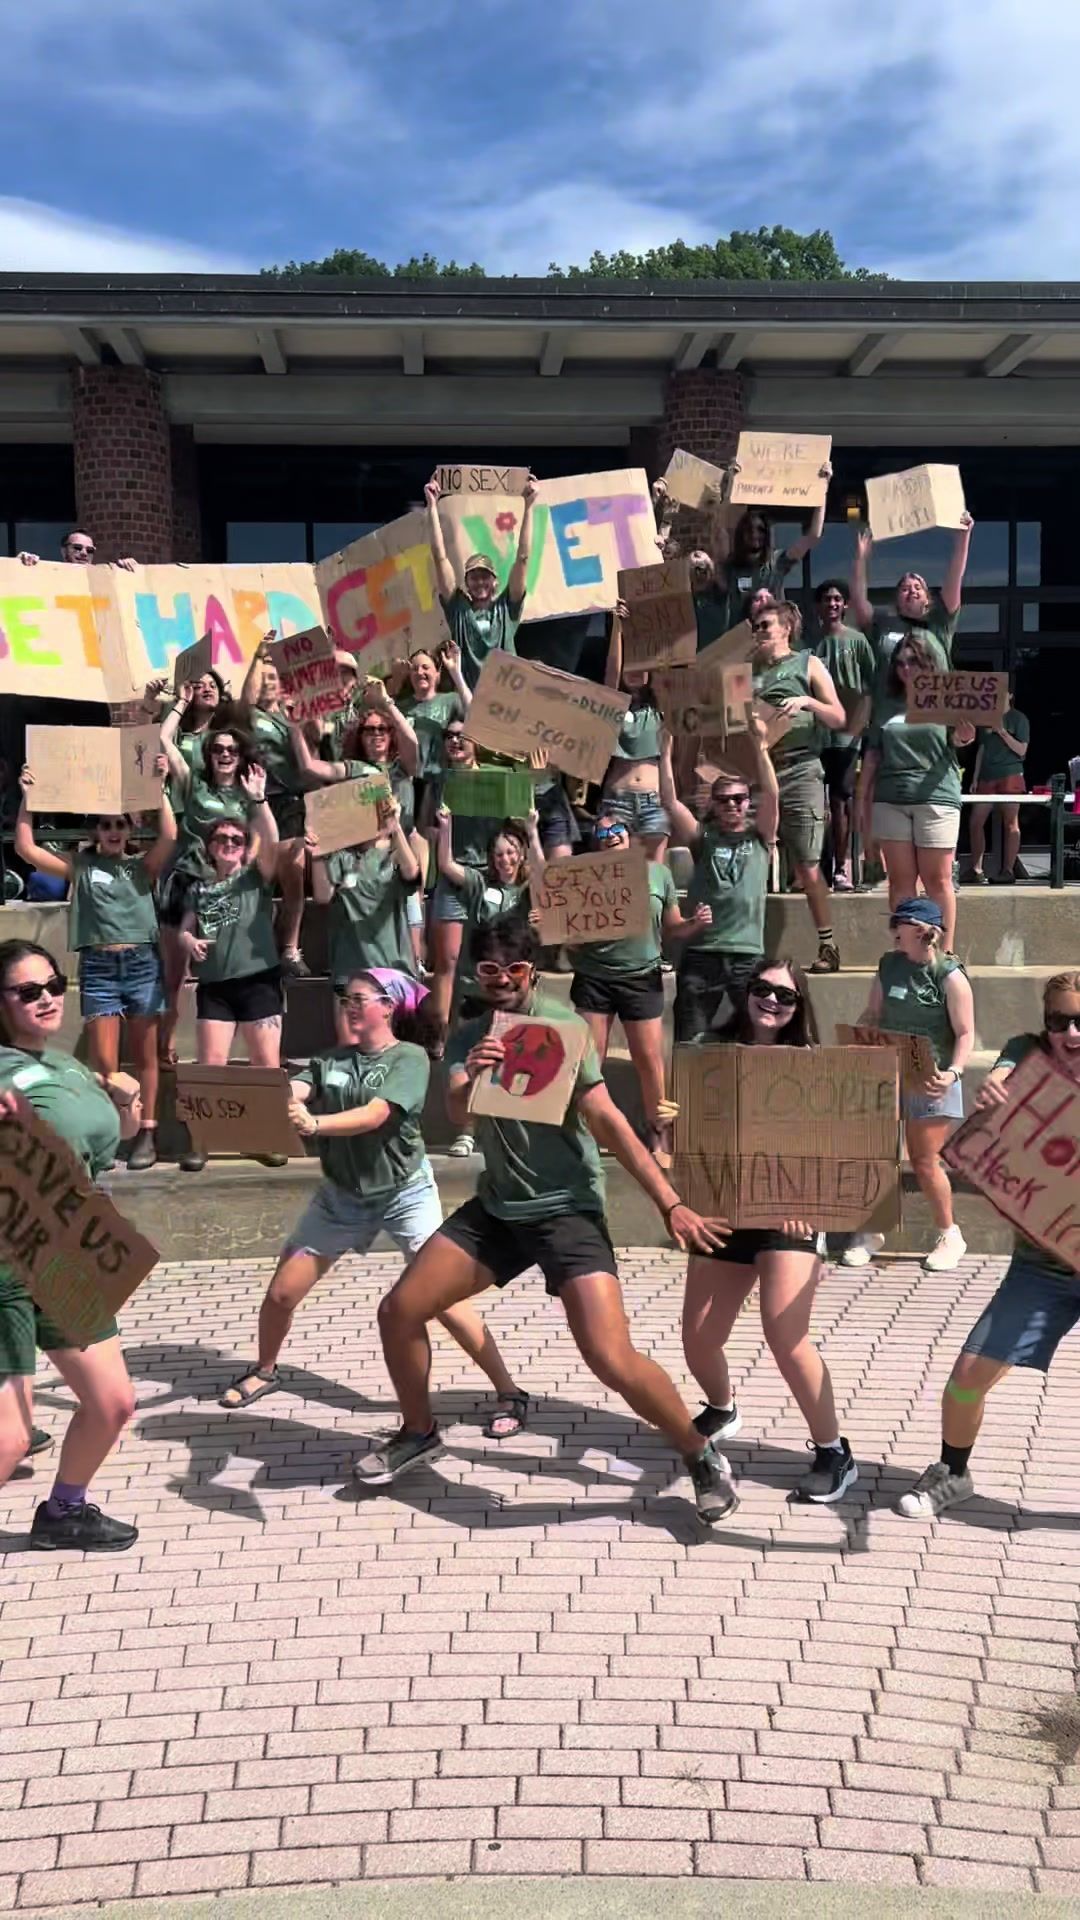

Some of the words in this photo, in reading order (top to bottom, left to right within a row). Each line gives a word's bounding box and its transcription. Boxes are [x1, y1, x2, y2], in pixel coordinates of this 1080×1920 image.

[440, 468, 462, 491] NO
[135, 590, 318, 669] HARD
[327, 543, 434, 655] GET
[283, 637, 313, 662] NO
[496, 664, 526, 692] NO
[913, 674, 966, 691] GIVE
[971, 676, 998, 692] US
[488, 701, 521, 723] ON
[914, 694, 938, 710] UR
[944, 693, 998, 711] KIDS!
[543, 863, 625, 889] GIVE
[536, 889, 568, 910] US
[577, 886, 632, 908] YOUR
[565, 908, 626, 935] KIDS
[696, 1146, 881, 1208] WANTED
[79, 1215, 130, 1273] US
